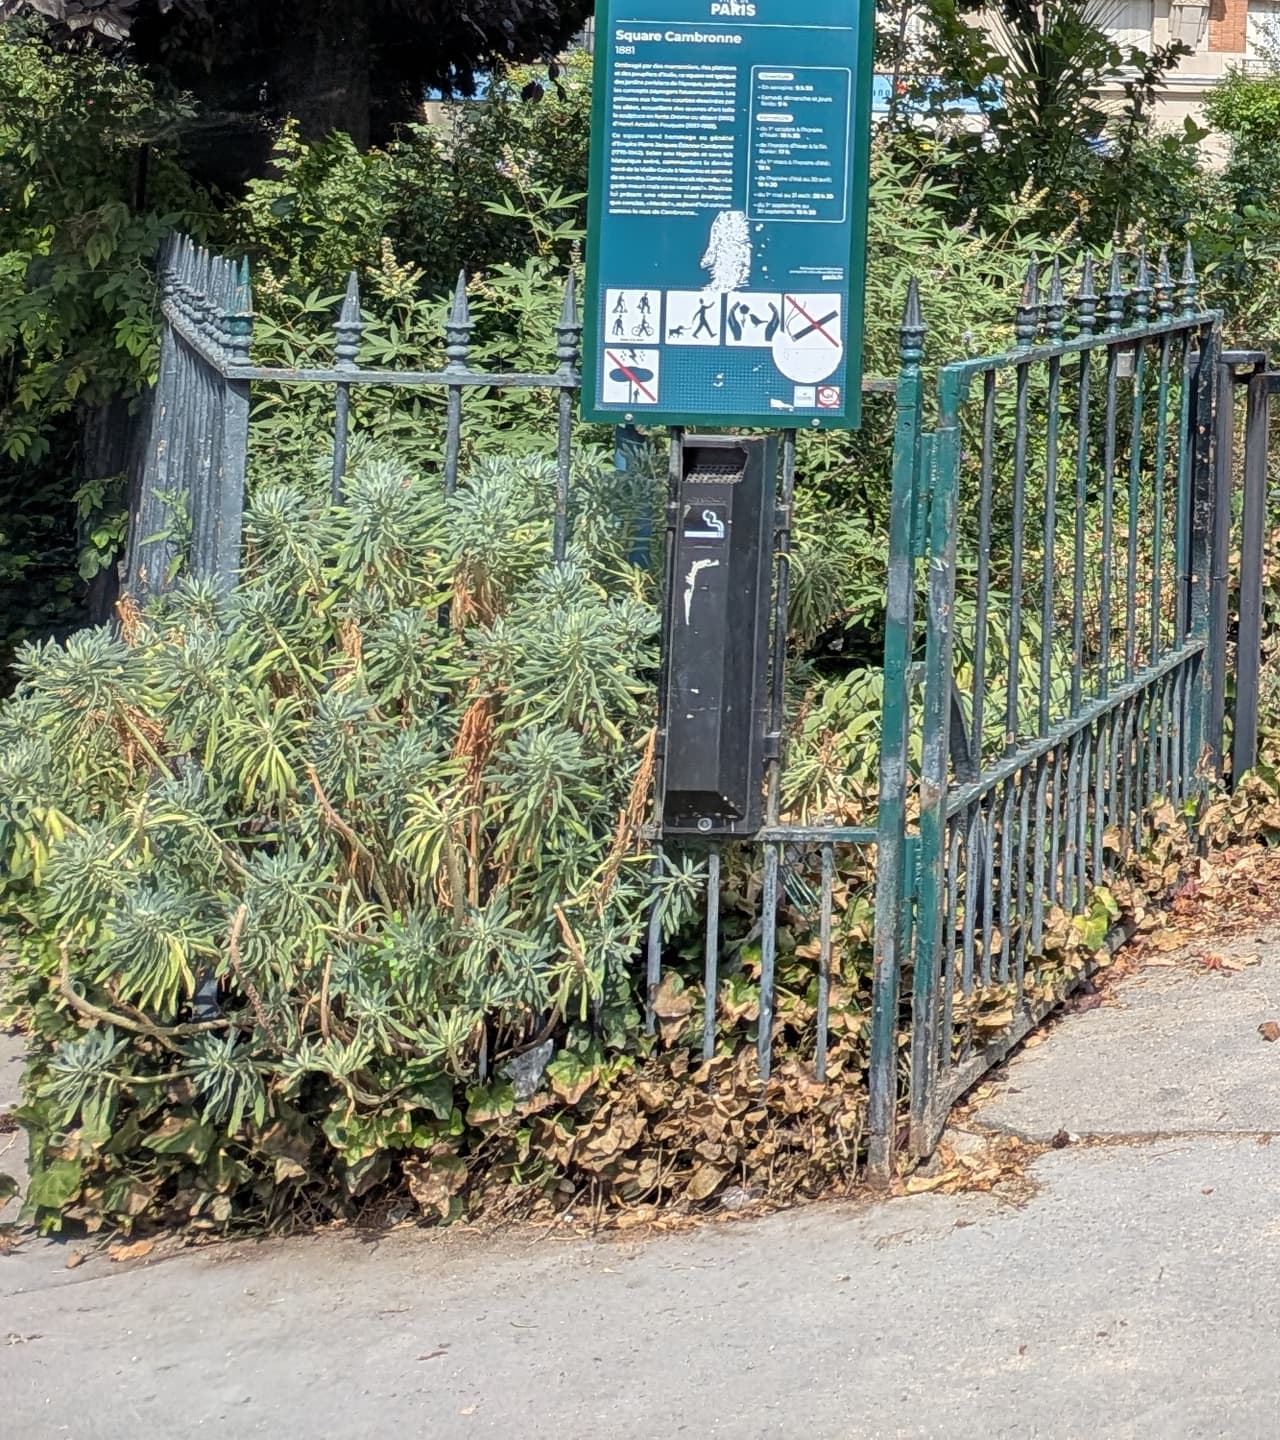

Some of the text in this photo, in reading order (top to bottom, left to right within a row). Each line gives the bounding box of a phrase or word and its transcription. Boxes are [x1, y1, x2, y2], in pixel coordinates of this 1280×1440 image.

[711, 3, 756, 16] PARIS
[616, 29, 742, 44] Square Cambronne
[615, 46, 635, 55] 1881
